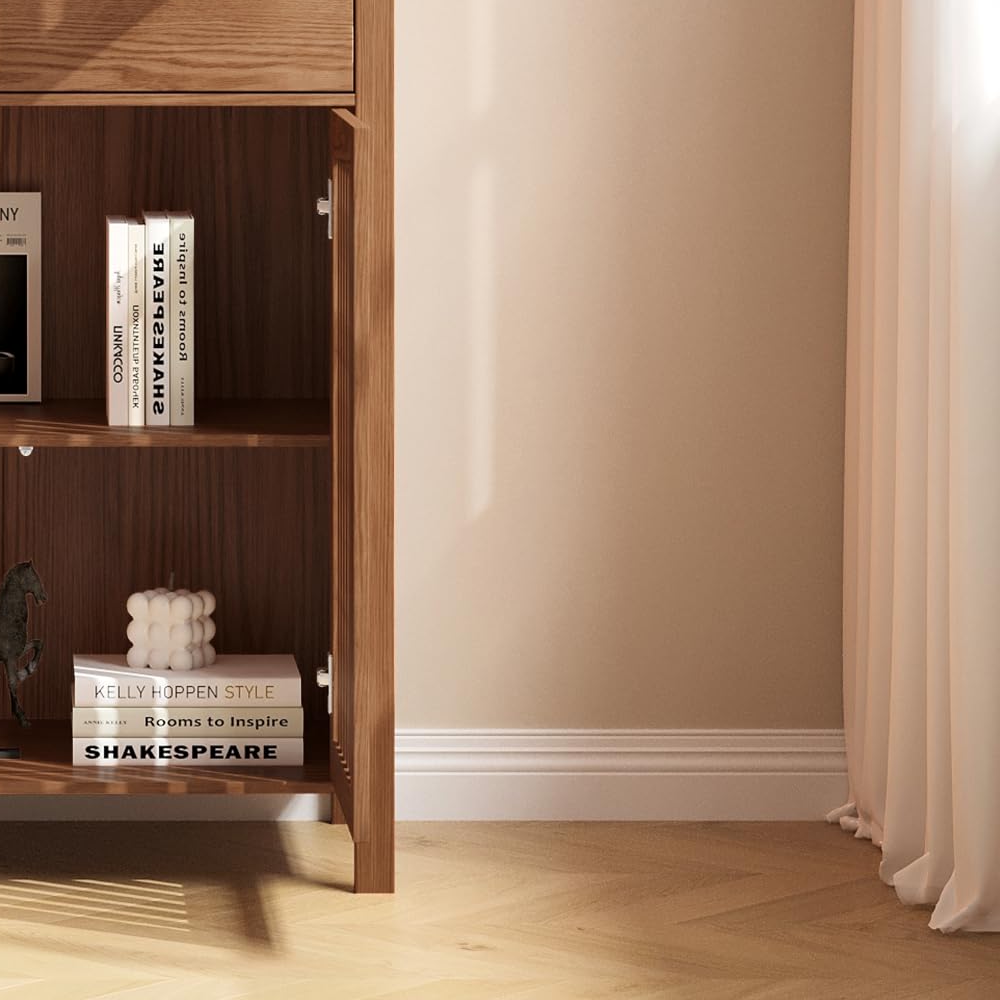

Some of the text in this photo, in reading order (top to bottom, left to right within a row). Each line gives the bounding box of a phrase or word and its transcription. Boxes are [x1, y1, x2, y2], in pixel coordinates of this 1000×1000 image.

[95, 686, 274, 699] KELLY HOPPEN STYLE
[145, 716, 288, 729] Rooms to Inspire
[85, 745, 277, 759] SHAKESPEARE
